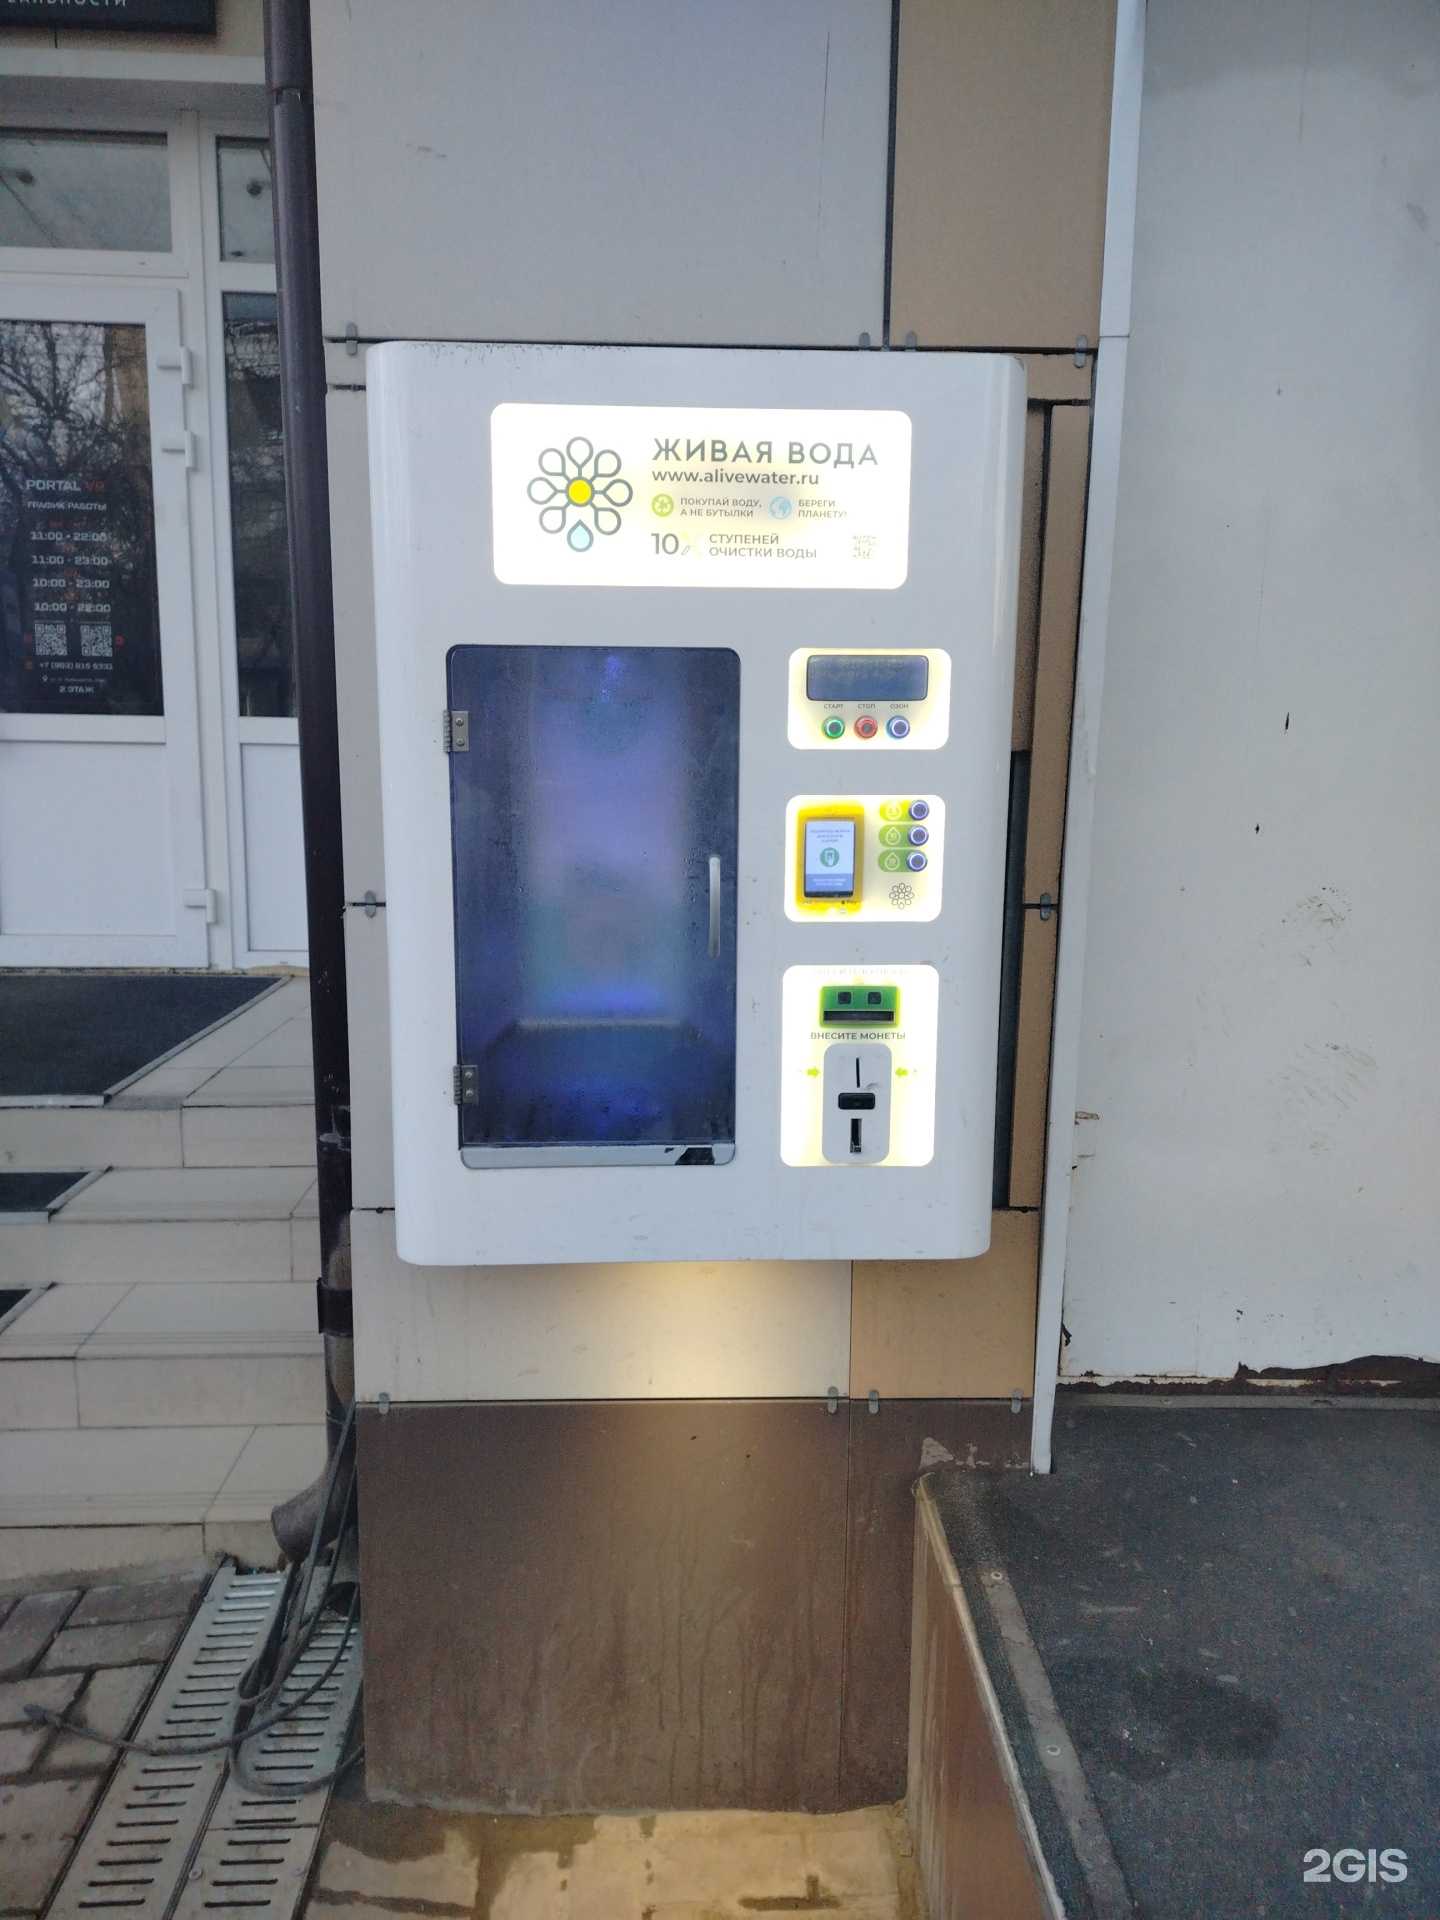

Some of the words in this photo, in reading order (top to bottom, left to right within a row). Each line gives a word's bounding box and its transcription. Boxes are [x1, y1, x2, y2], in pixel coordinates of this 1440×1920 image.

[652, 438, 773, 464] ЖИВАЯ
[788, 441, 878, 469] ВОДА
[652, 468, 819, 485] www.alivewater.ru
[25, 479, 81, 491] PORTAL
[67, 502, 107, 511] РАБОТЫ
[680, 497, 730, 507] ПОКУПАЙ
[732, 498, 763, 509] ВОДУ,
[798, 499, 836, 508] БЕРЕГИ
[680, 508, 688, 517] А
[690, 508, 703, 517] НЕ
[706, 509, 754, 518] БУТЫЛКИ
[30, 531, 63, 541] 11:00
[709, 532, 779, 545] СТУПЕНЕЙ
[651, 532, 680, 555] 10
[709, 547, 773, 558] ОЧИСТКИ
[776, 547, 817, 560] ВОДЫ
[31, 555, 64, 565] 11:00
[810, 1032, 857, 1041] ВНЕСИТЕ
[860, 1032, 906, 1041] МОНЕТЫ
